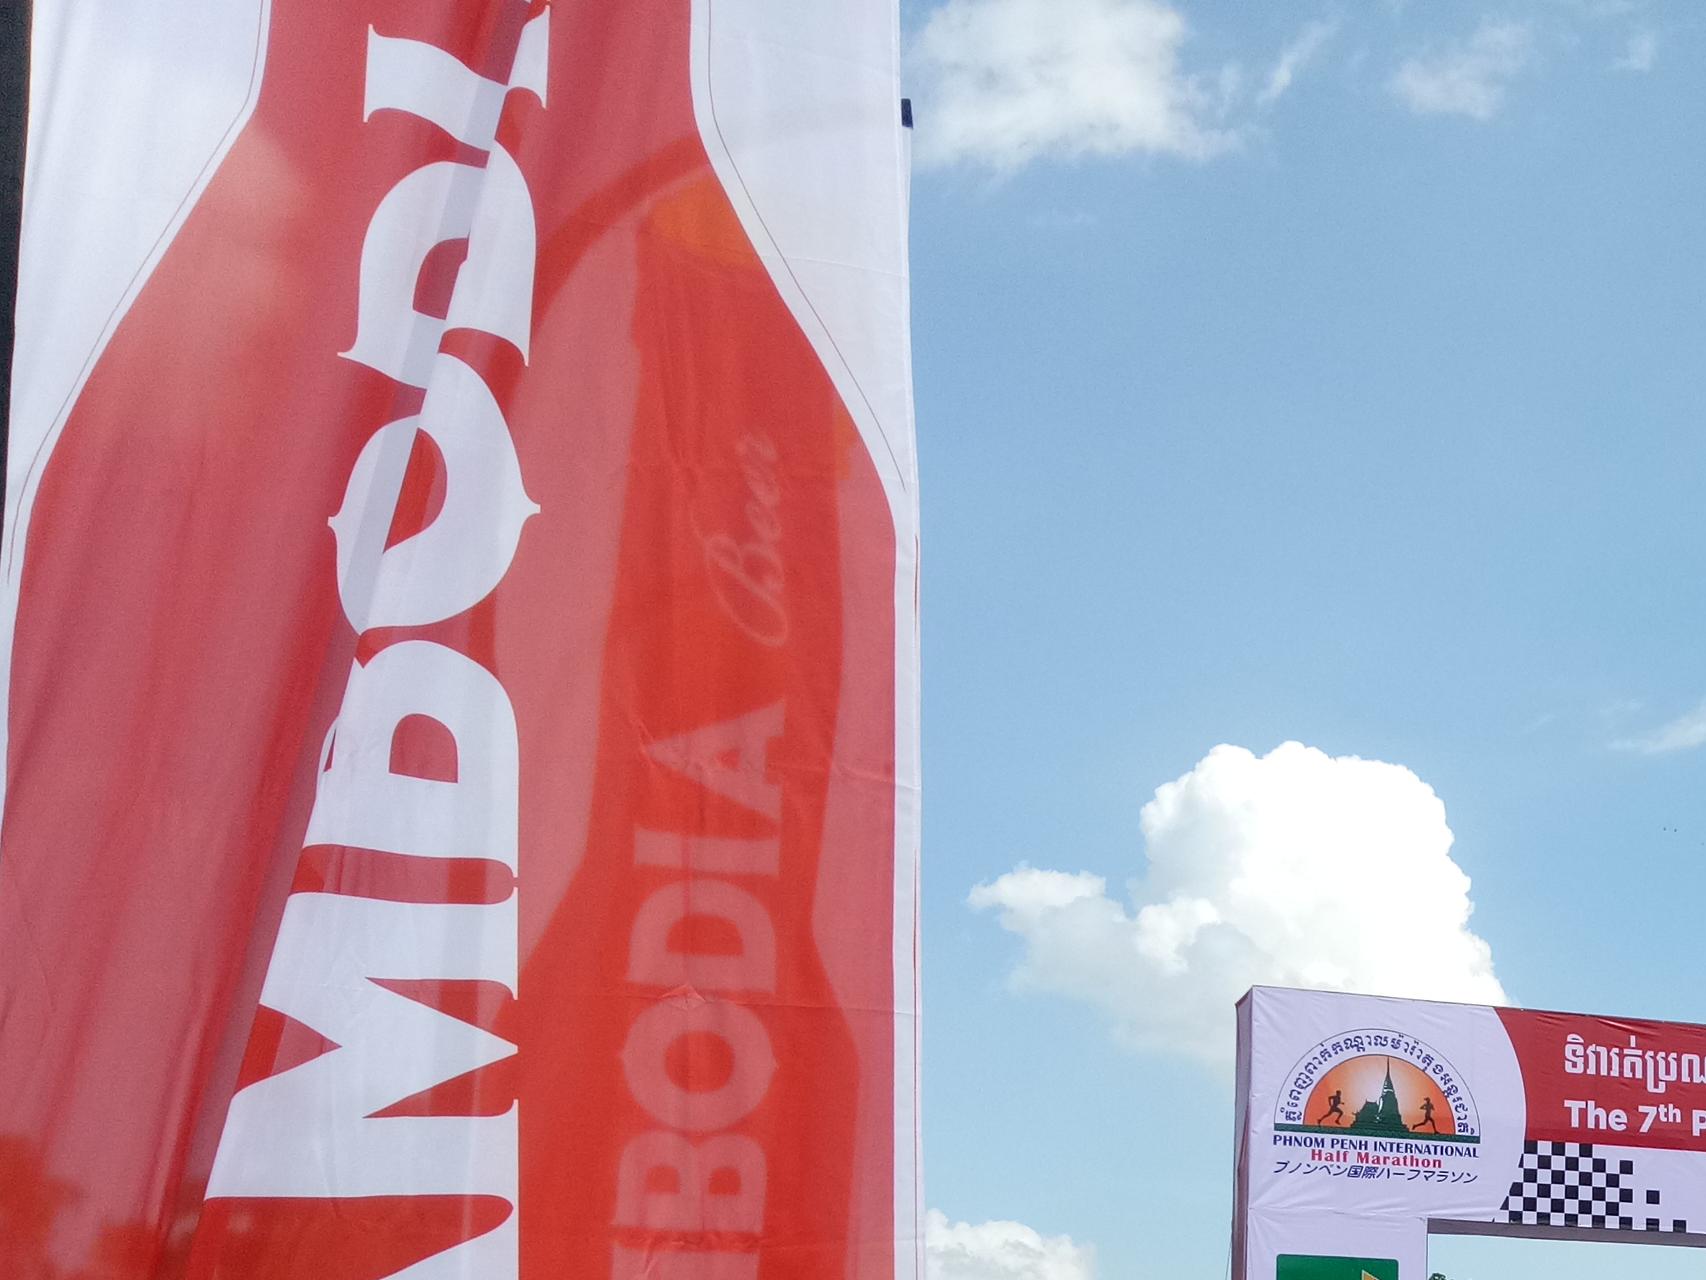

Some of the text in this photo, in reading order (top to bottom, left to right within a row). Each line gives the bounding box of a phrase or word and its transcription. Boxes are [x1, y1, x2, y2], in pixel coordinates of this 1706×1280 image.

[1564, 1100, 1628, 1132] The
[1638, 1104, 1681, 1133] 7th
[1272, 1134, 1479, 1158] PHNOM PENH INTERNATIONAL
[1311, 1148, 1443, 1169] Half Marathon
